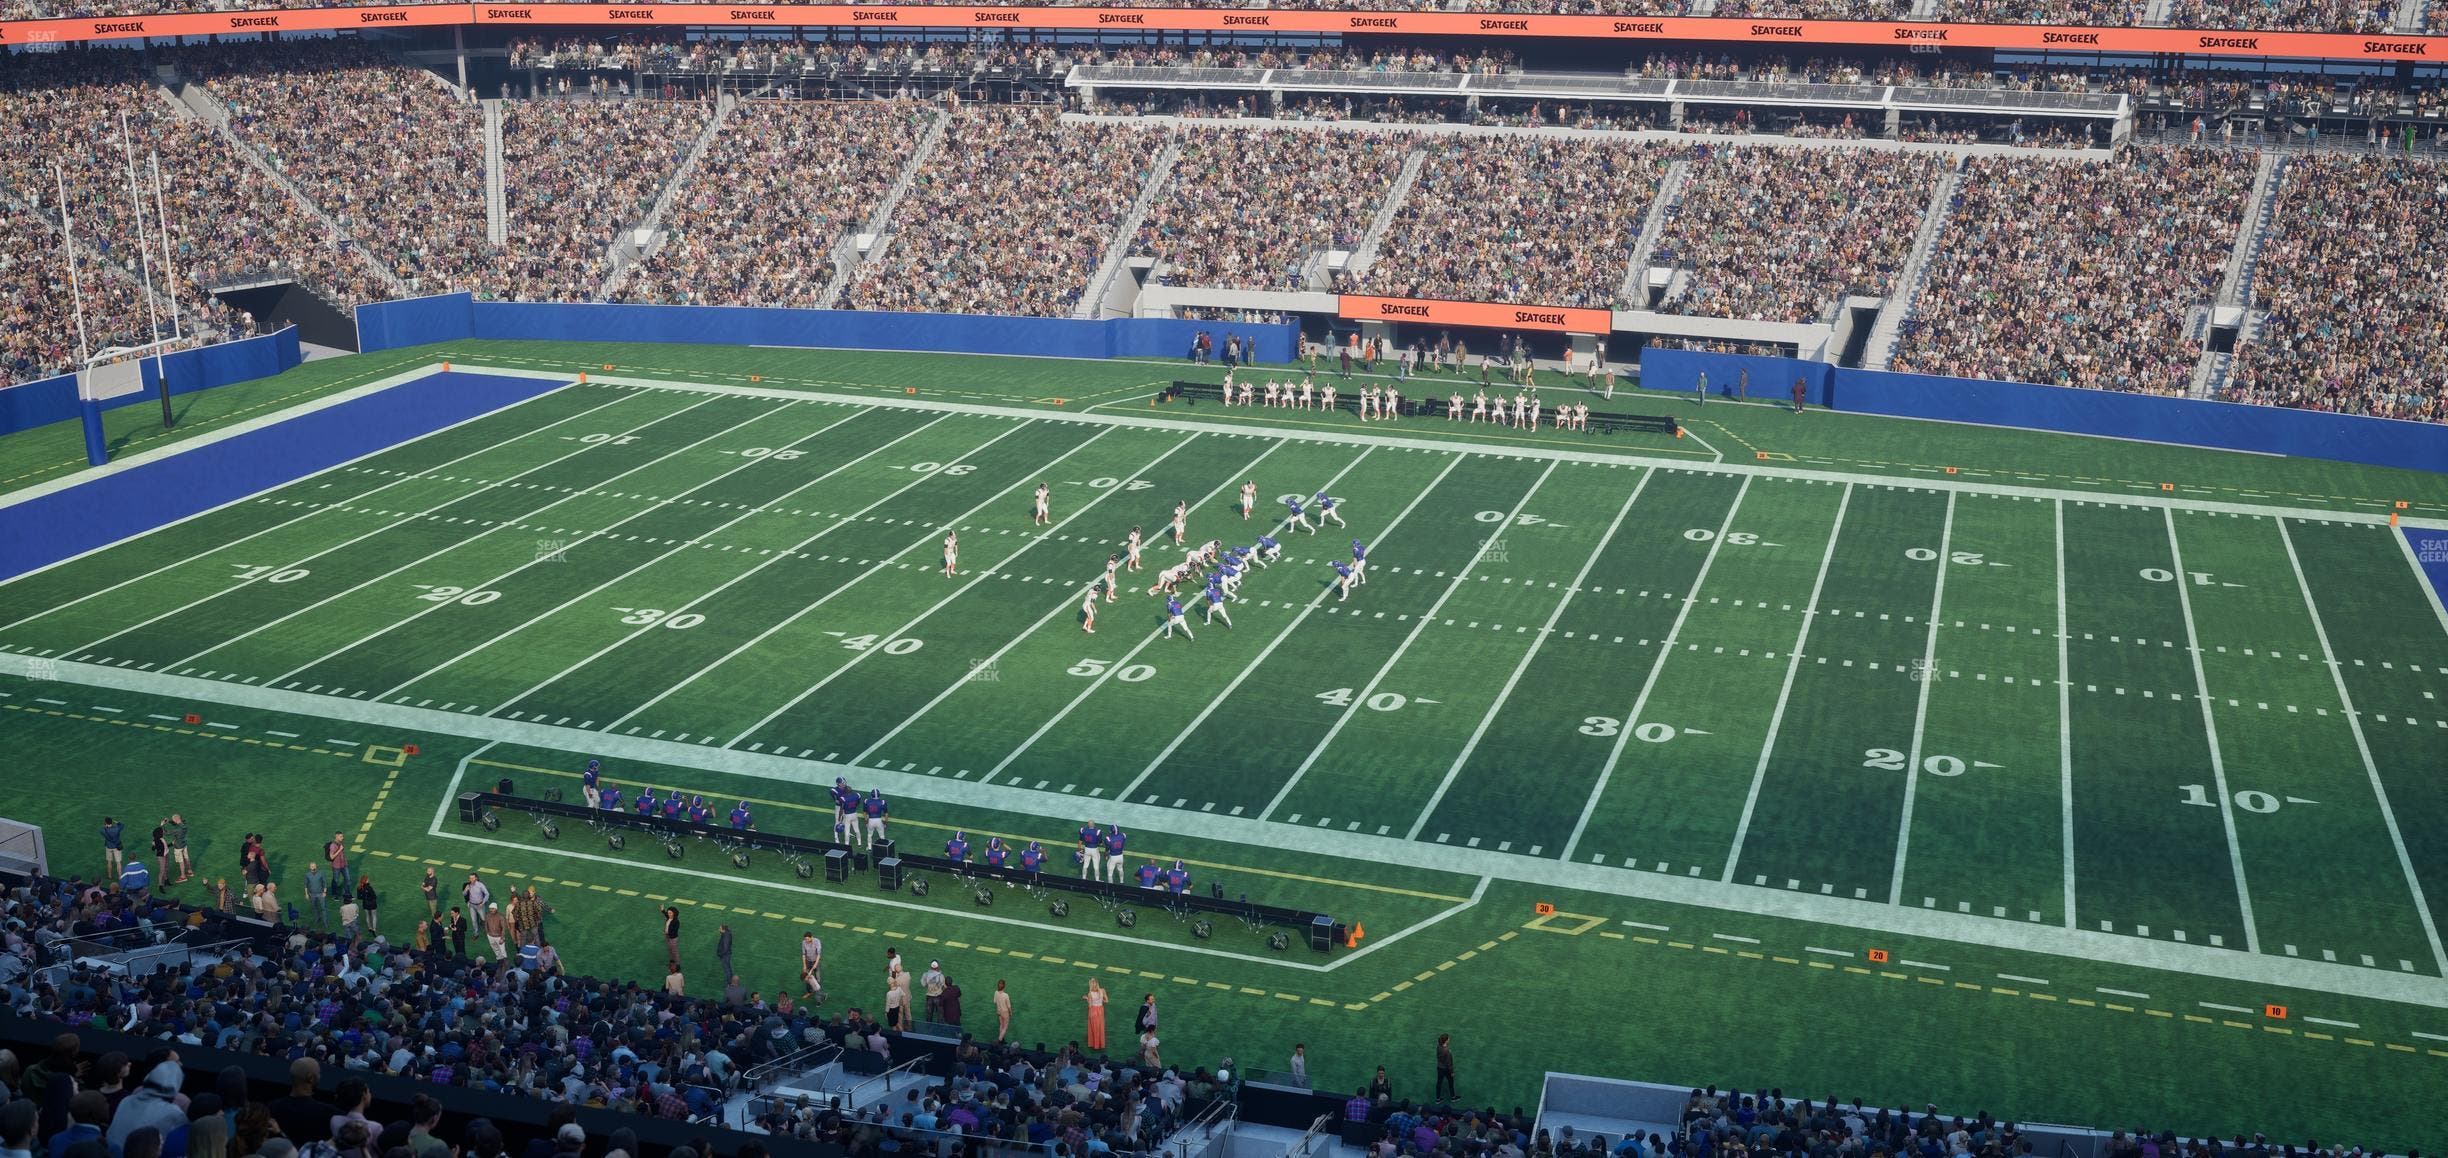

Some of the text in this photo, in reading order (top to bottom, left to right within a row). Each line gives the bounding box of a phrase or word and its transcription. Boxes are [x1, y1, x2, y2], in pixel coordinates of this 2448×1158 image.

[361, 12, 408, 22] SEATGEEK
[488, 10, 531, 19] SEATGEEK
[609, 10, 653, 20] SEATGEEK
[731, 11, 775, 20] SEATGEEK
[854, 12, 898, 21] SEATGEEK
[976, 13, 1020, 22] SEATGEEK
[1099, 14, 1144, 23] SEATGEEK
[1224, 16, 1269, 25] SEATGEEK
[95, 22, 144, 34] SEATGEEK
[231, 17, 279, 28] SEATGEEK
[1351, 18, 1397, 27] SEATGEEK
[1481, 20, 1528, 30] SEATGEEK
[1614, 23, 1663, 33] SEATGEEK
[1751, 26, 1803, 36] SEATGEEK
[1895, 29, 1948, 40] SEATGEEK
[2043, 33, 2099, 44] SEATGEEK
[2200, 37, 2258, 49] SEATGEEK
[2364, 42, 2426, 54] SEATGEEK
[1382, 304, 1430, 316] SEATGEEK
[1516, 312, 1565, 325] SEATGEEK
[580, 433, 642, 445] 10
[741, 447, 808, 460] 20
[910, 461, 978, 475] 30
[1088, 477, 1155, 491] 40
[1474, 511, 1546, 525] 40
[1684, 529, 1759, 545] 30
[1905, 548, 1983, 565] 20
[231, 565, 310, 583] 10
[2139, 568, 2215, 585] 10
[415, 586, 502, 606] 20
[620, 609, 705, 629] 30
[839, 634, 924, 655] 40
[1066, 658, 1157, 682] 50
[1314, 688, 1407, 711] 40
[1578, 717, 1676, 743] 30
[1862, 748, 1966, 777] 20
[2178, 784, 2281, 814] 10
[1540, 904, 1550, 913] 30
[1873, 951, 1884, 960] 20
[2272, 1007, 2281, 1016] 10
